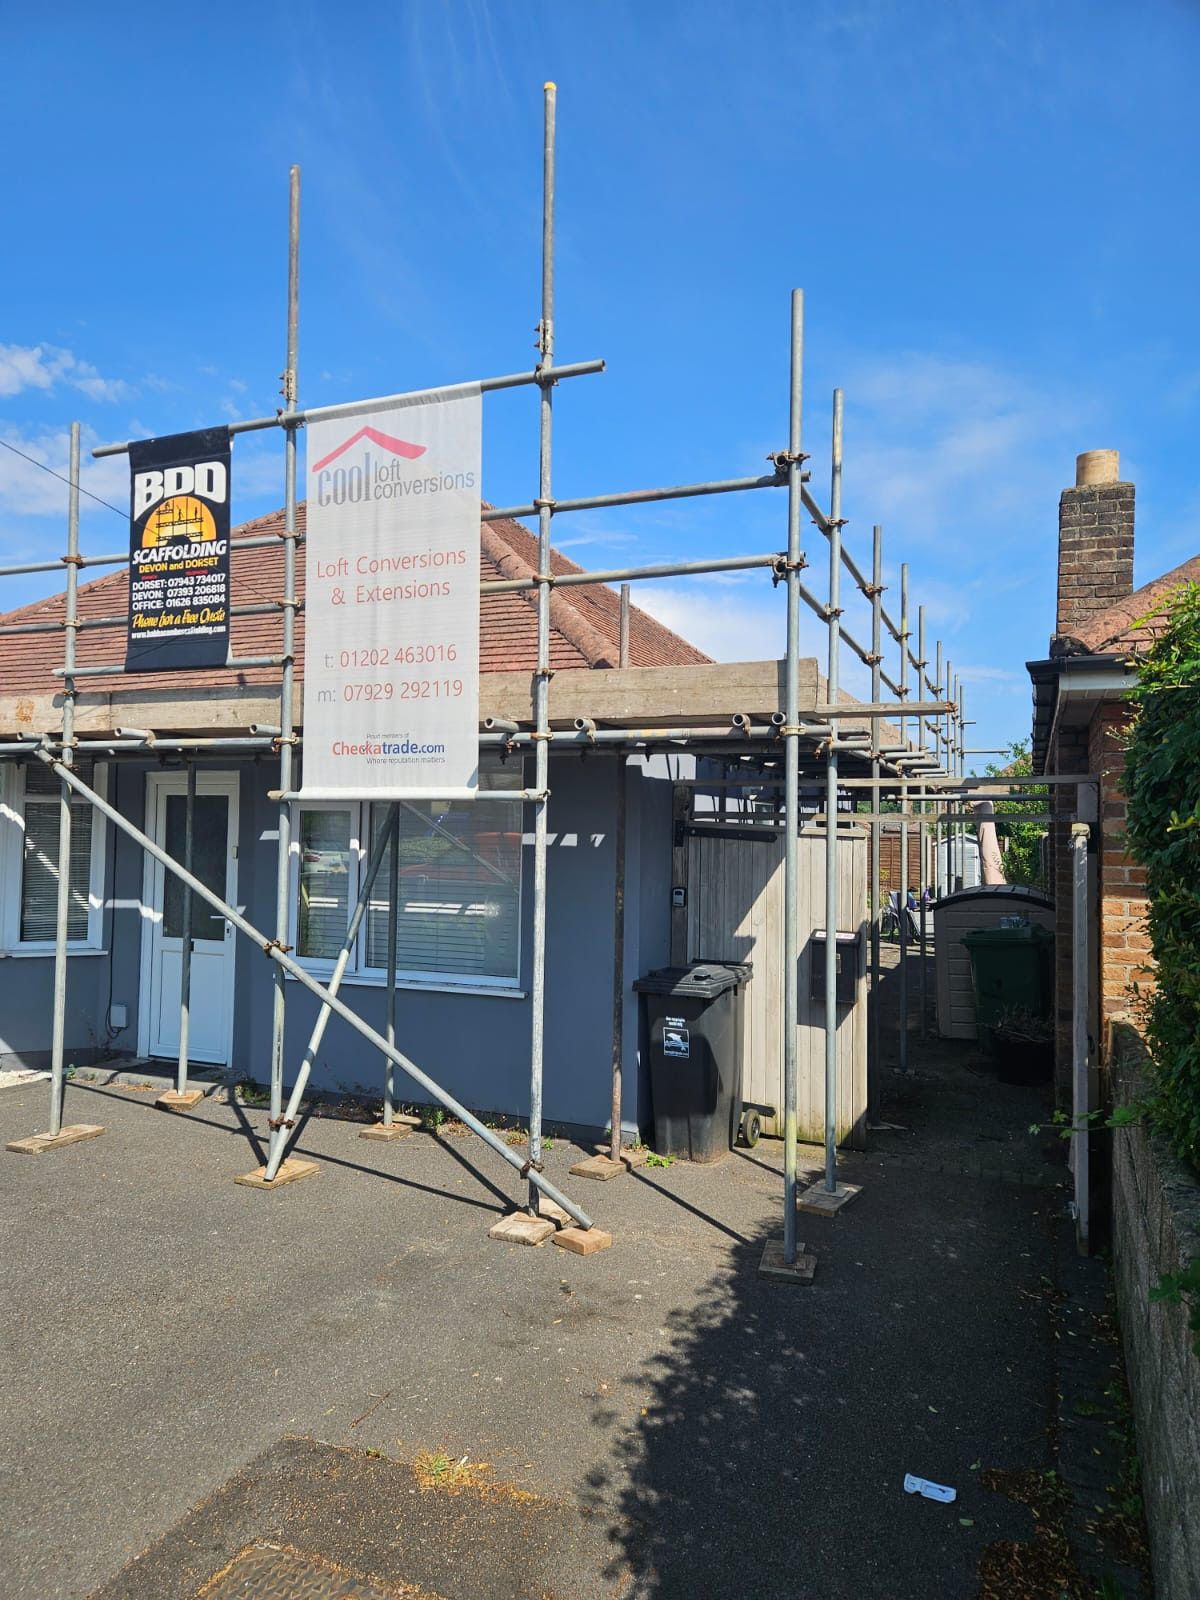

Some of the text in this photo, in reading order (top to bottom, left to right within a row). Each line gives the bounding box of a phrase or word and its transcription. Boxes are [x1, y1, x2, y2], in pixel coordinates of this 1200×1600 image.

[317, 452, 370, 507] cool
[374, 458, 401, 484] loft
[134, 461, 226, 521] BDD
[374, 471, 475, 500] conversions
[132, 539, 227, 564] SCAFFOLDING
[317, 548, 466, 578] Loft Conversions
[139, 556, 219, 573] DEVON and DORSET
[132, 579, 167, 591] DORSET:
[168, 576, 194, 587] 07943
[195, 573, 226, 584] 734017
[132, 584, 226, 601] DEVON: 07393 206818
[331, 580, 451, 606] & Extensions
[132, 594, 226, 611] OFFICE: 01626 835084
[132, 607, 226, 628] Phone for a Free Quote
[324, 644, 457, 669] t: 01202 463016
[317, 679, 463, 703] m: 07929 292119
[332, 739, 445, 756] Checkatrade.com
